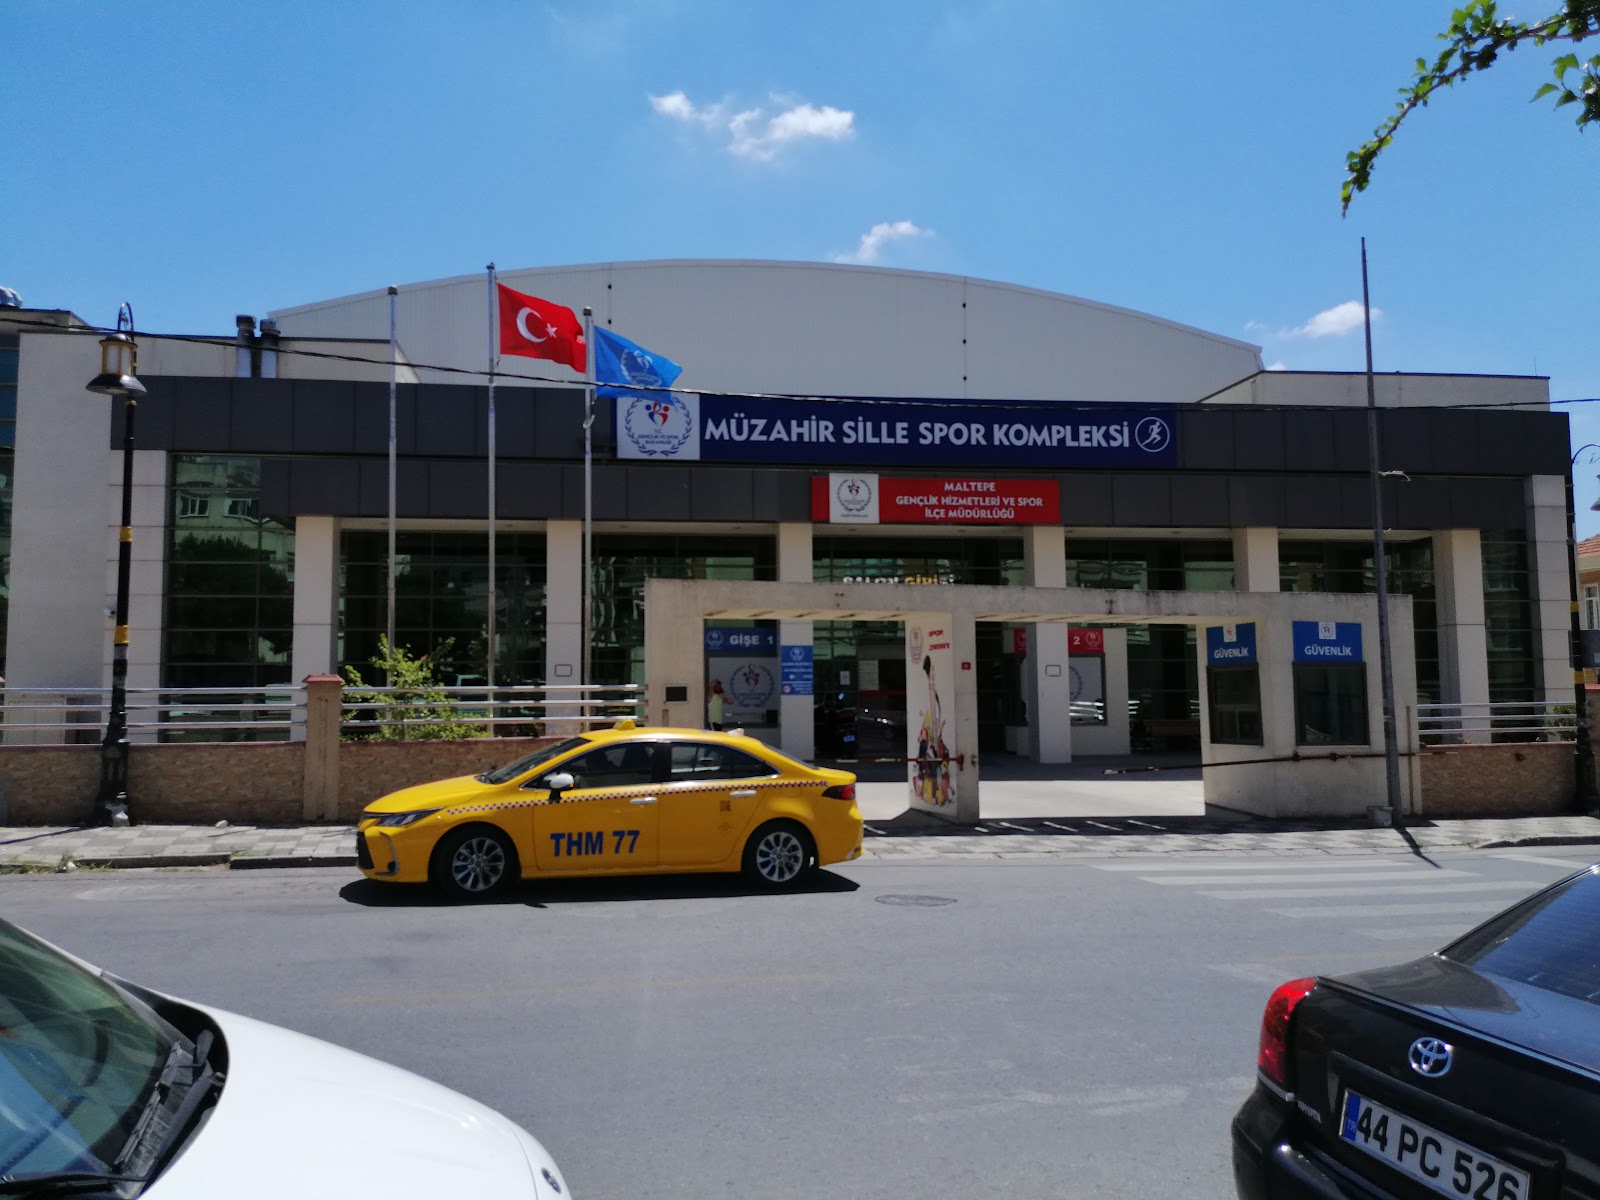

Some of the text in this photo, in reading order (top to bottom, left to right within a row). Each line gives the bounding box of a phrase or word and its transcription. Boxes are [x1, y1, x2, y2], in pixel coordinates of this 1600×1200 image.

[704, 412, 1130, 448] MÜZAHİR SİLLE SPOR KOMPLEKSİ
[944, 482, 996, 492] MALTEPE
[896, 495, 1043, 507] GENÇLİK HİZMETLERİ VE SPOR
[925, 507, 1015, 520] İLÇE MÜDÜRLÜĞÜ
[729, 633, 774, 647] GİŞE 1
[1073, 636, 1081, 645] 2
[1214, 646, 1249, 658] GÜVENLİK
[1304, 644, 1352, 656] GÜVENLİK
[550, 830, 640, 857] THM 77
[1357, 1106, 1520, 1200] 44 PC 526
